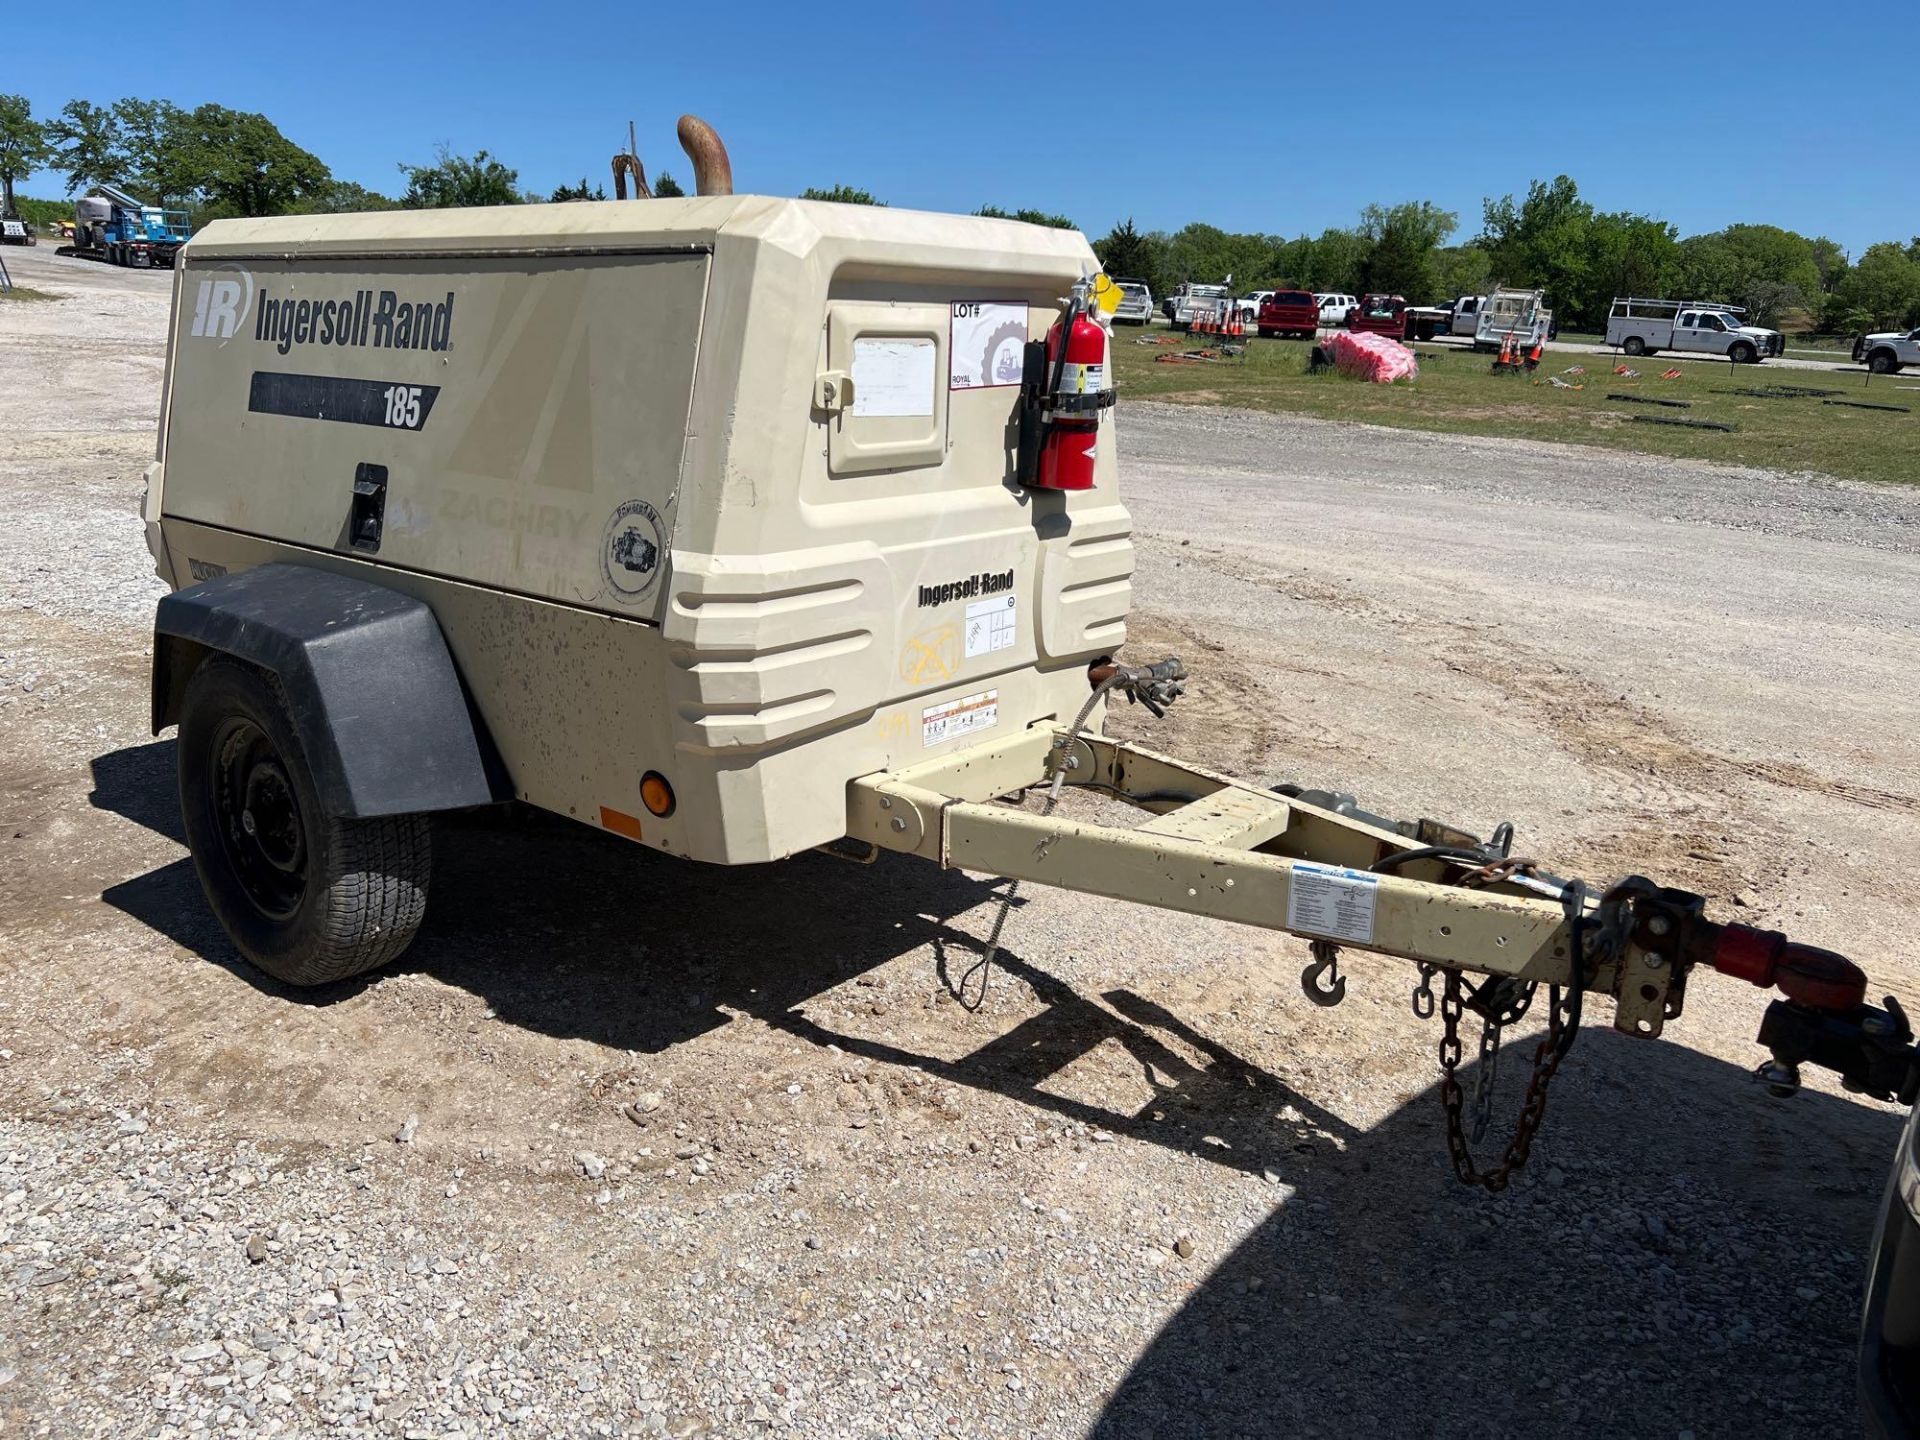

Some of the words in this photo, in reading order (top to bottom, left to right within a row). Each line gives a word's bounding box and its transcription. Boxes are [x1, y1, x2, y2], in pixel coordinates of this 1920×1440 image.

[953, 303, 980, 318] LOT#
[952, 374, 971, 384] ROYAL
[384, 386, 423, 428] 185
[438, 488, 592, 539] ZACHRY
